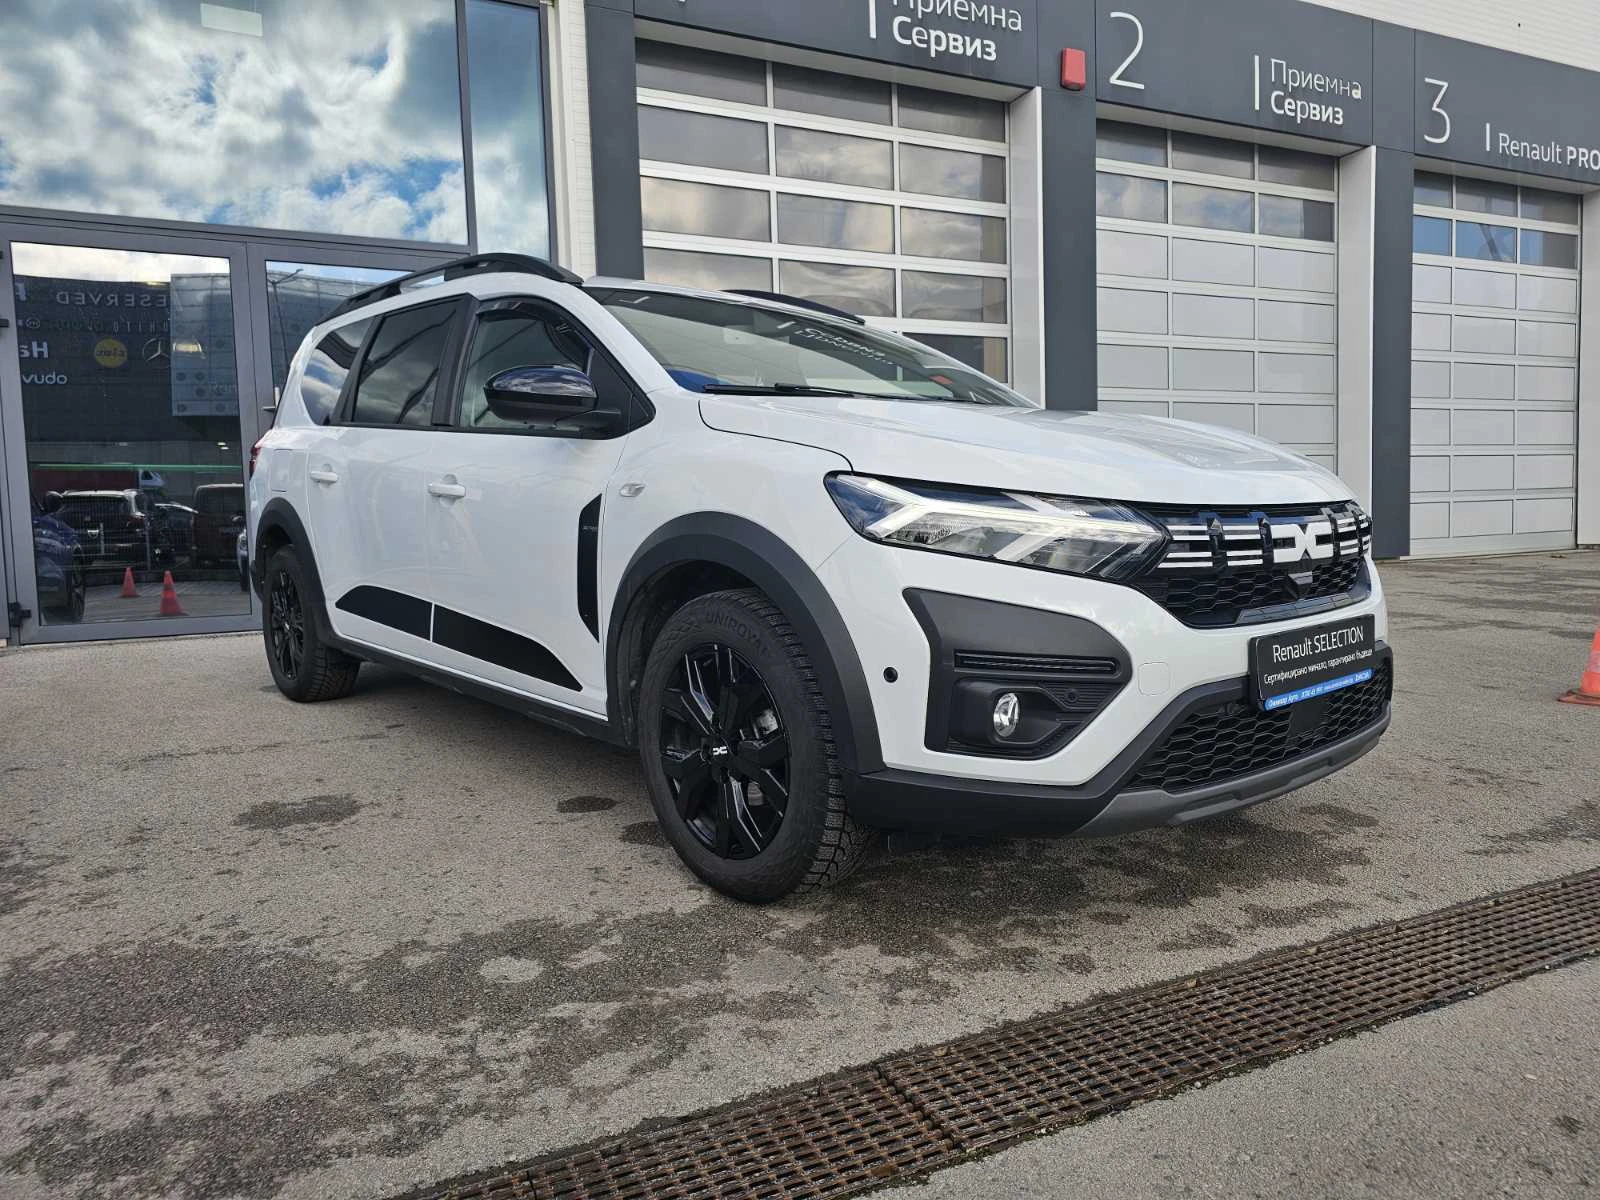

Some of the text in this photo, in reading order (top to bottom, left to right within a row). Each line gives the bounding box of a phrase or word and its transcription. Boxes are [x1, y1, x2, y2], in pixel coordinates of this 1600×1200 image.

[893, 15, 997, 61] Сервиз
[1109, 11, 1145, 90] 2
[1270, 58, 1362, 100] Приемна
[1270, 90, 1344, 125] Сервиз
[1423, 77, 1451, 144] 3
[1498, 132, 1600, 171] Renault PRO
[1272, 625, 1364, 664] Renault SELECTION
